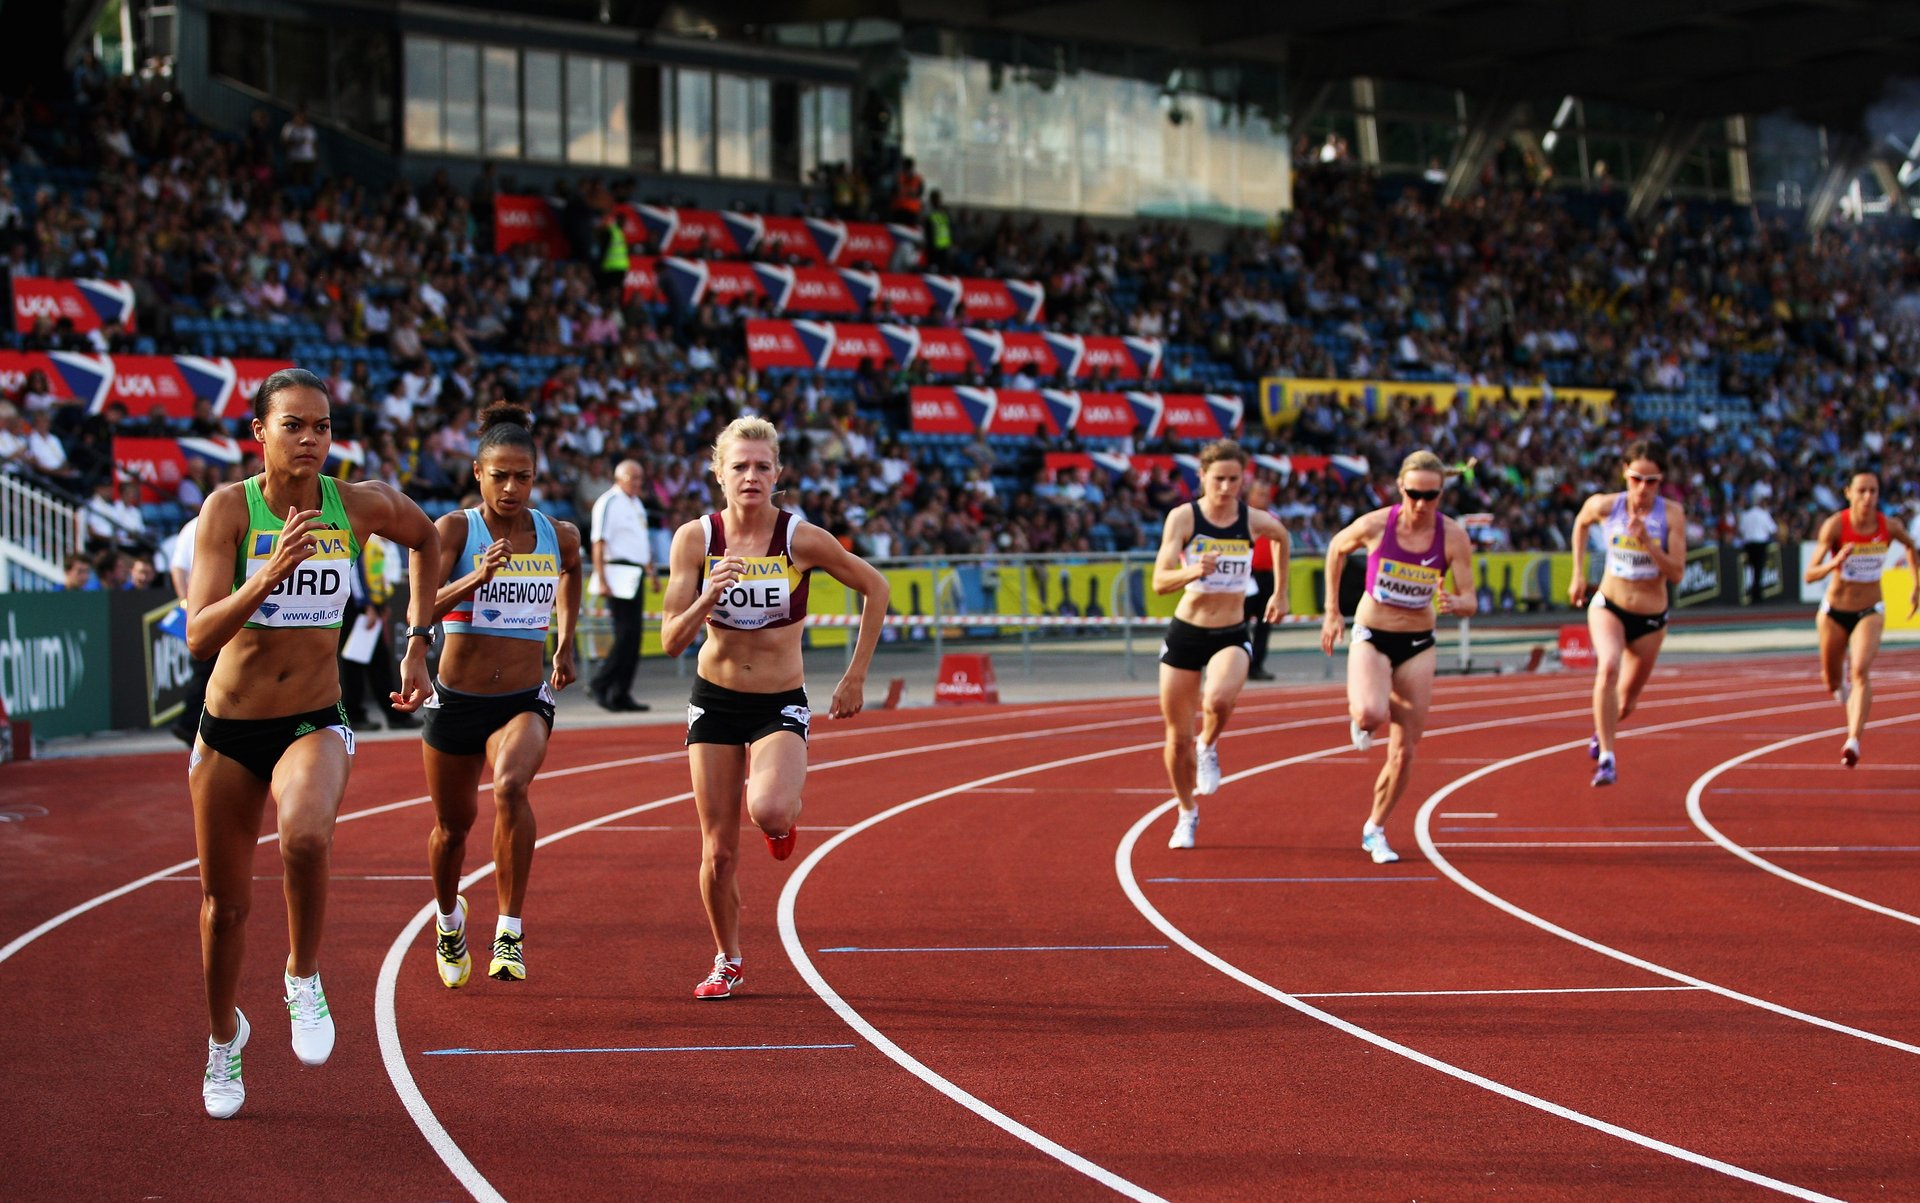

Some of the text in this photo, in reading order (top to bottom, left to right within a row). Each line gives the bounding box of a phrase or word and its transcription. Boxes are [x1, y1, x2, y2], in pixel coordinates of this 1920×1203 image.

[505, 560, 553, 572] AVIVA
[743, 562, 782, 576] VIVA
[1215, 560, 1247, 575] KETT
[480, 582, 554, 604] HAREWOOD
[282, 609, 339, 622] www.gll.org
